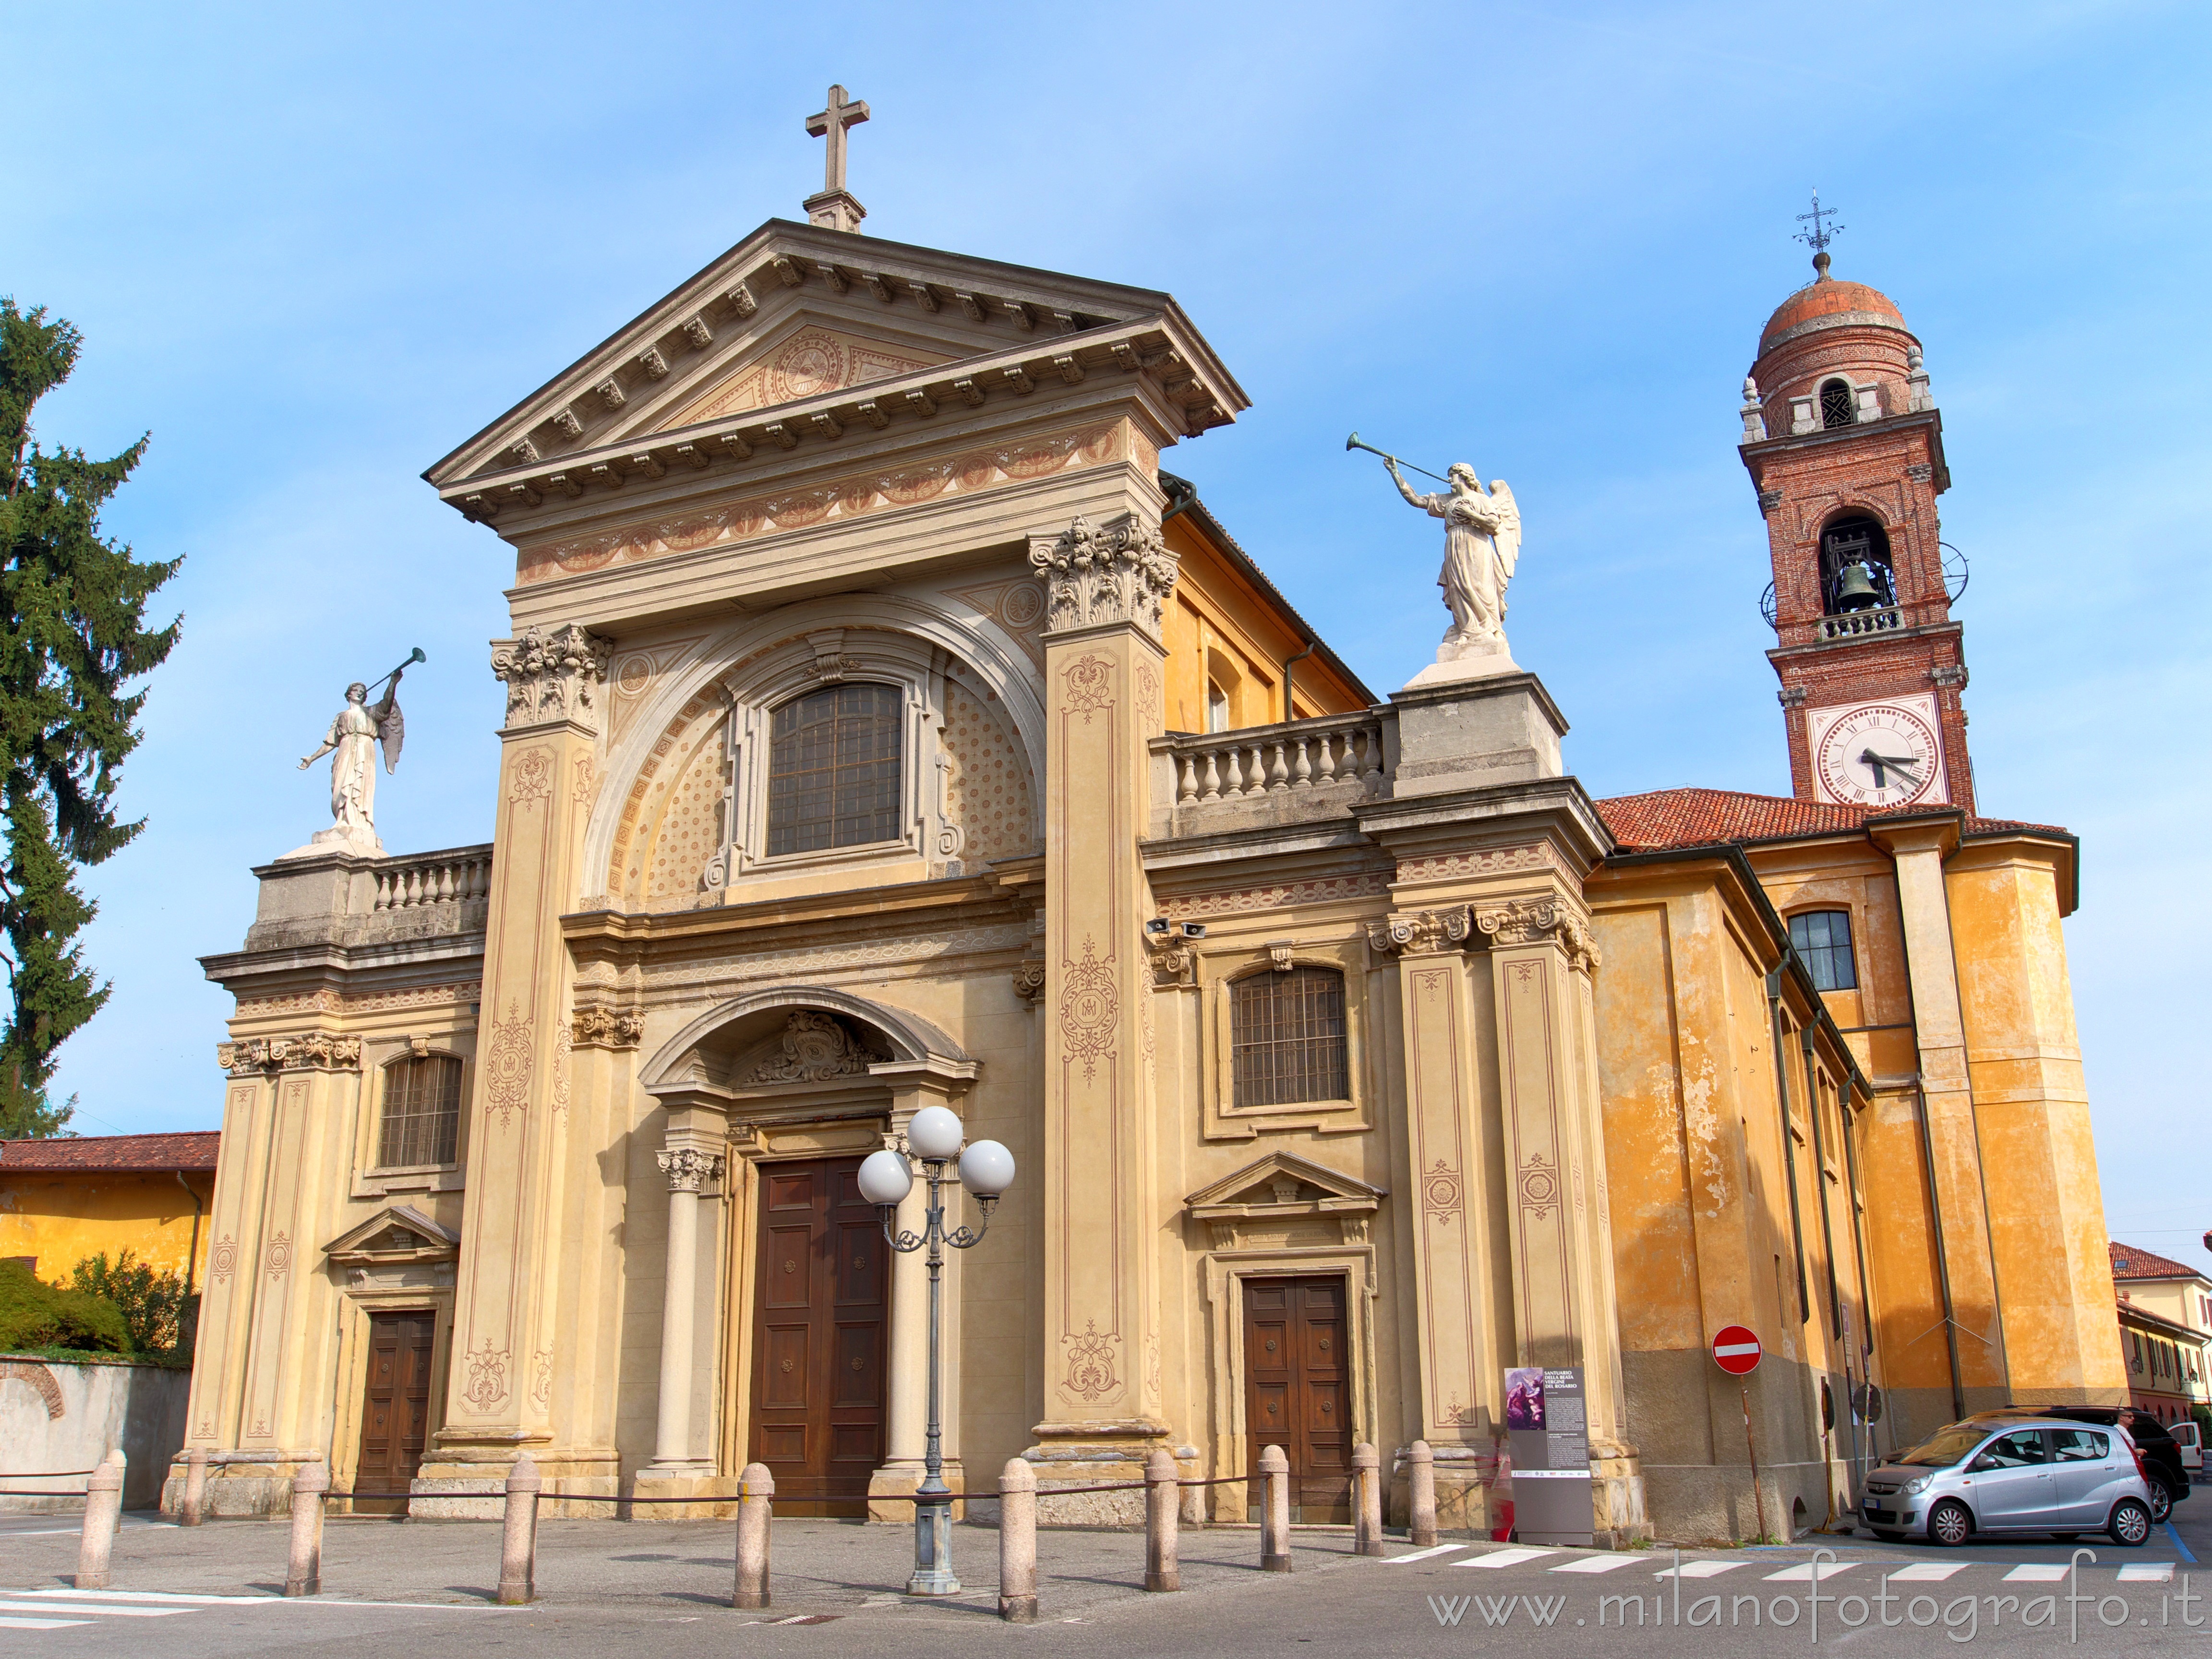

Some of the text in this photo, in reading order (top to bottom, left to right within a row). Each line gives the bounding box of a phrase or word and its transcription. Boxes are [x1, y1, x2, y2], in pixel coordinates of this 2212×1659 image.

[1867, 716, 1880, 727] XII
[1846, 724, 1858, 735] XI
[1907, 731, 1918, 740] II
[1914, 748, 1926, 758] III
